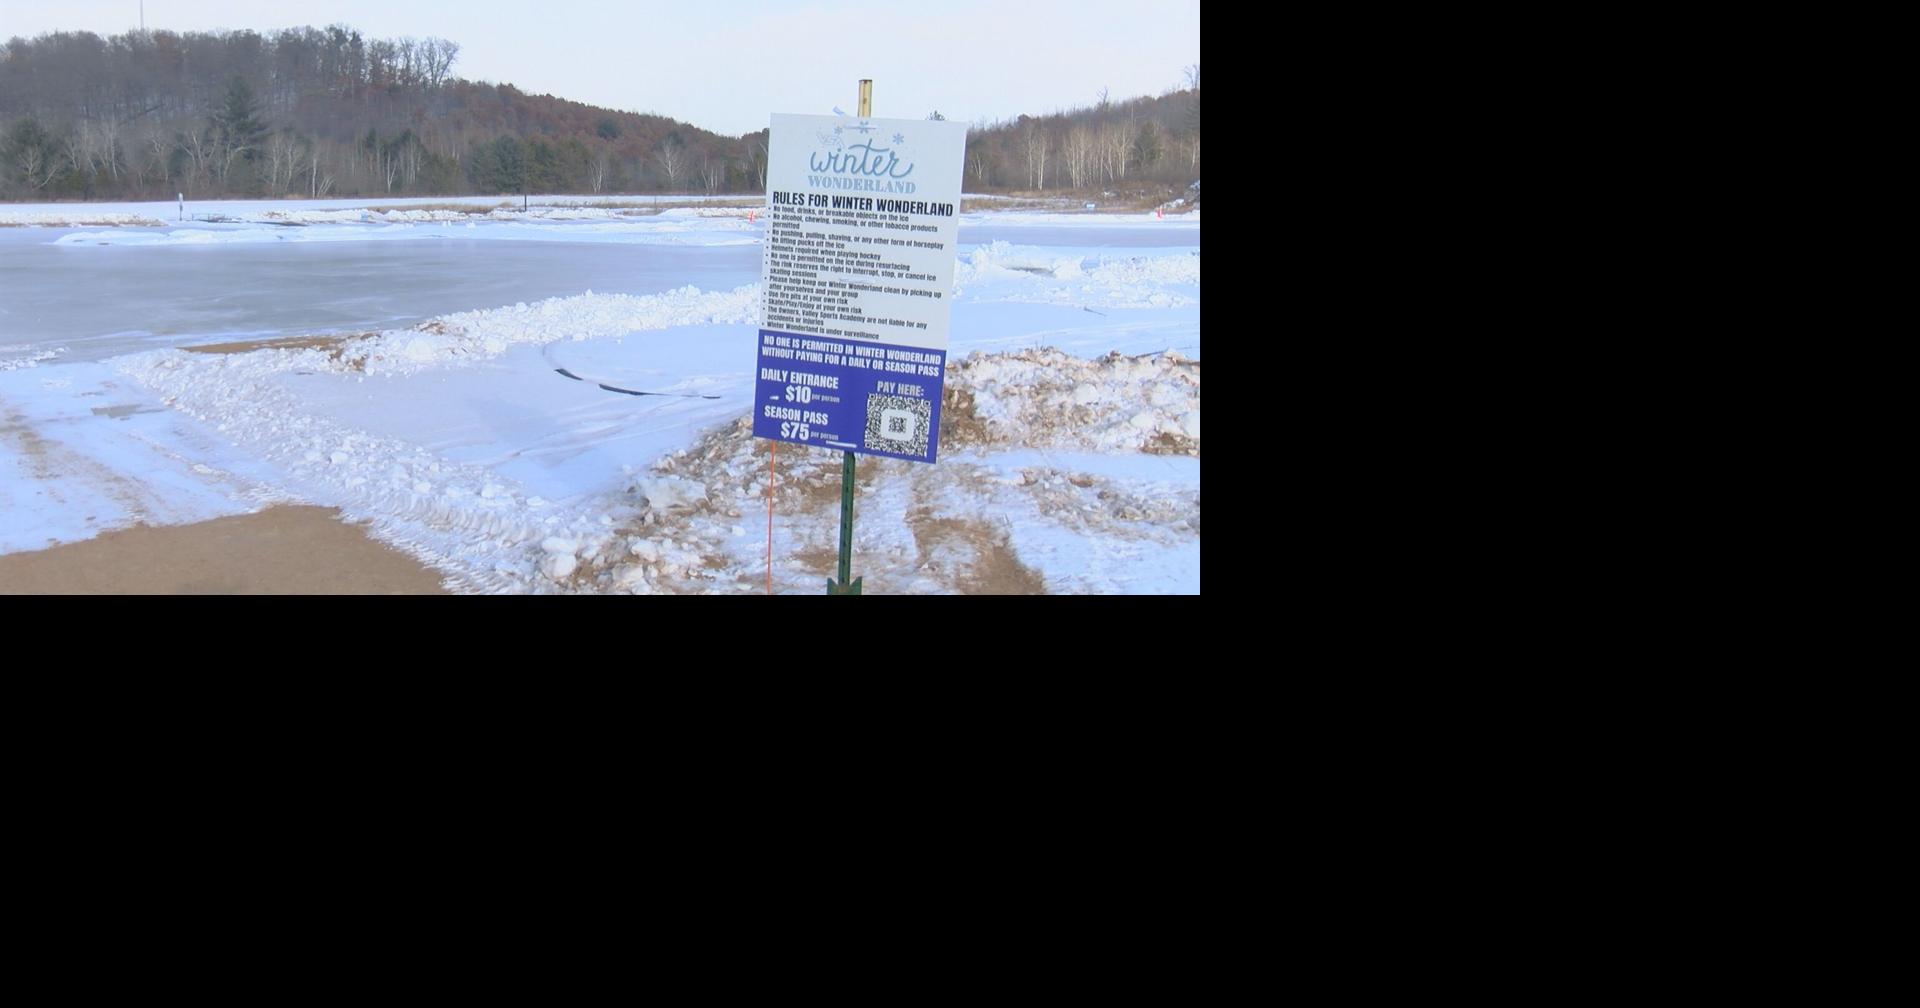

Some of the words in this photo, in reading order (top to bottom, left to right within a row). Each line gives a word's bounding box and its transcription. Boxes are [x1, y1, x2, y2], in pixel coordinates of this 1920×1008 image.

[810, 138, 915, 178] winter
[807, 175, 916, 195] WONDERLAND
[773, 191, 805, 206] RULES
[808, 194, 829, 208] FOR
[832, 196, 873, 211] WINTER
[876, 199, 953, 217] WONDERLAND
[826, 209, 854, 217] breakable
[856, 212, 878, 220] objects
[773, 221, 800, 230] permitted
[885, 222, 909, 230] tobacco
[911, 224, 938, 233] products
[798, 239, 814, 247] pucks
[914, 241, 944, 250] horseplay
[795, 247, 819, 255] required
[837, 250, 858, 259] playing
[860, 253, 881, 261] hockey
[794, 262, 818, 270] reserves
[797, 255, 825, 264] permitted
[856, 260, 874, 268] during
[876, 262, 910, 272] resurfacing
[770, 268, 791, 276] skating
[792, 270, 817, 278] sessions
[783, 285, 814, 294] yourselves
[827, 289, 840, 297] your
[841, 291, 858, 299] group
[789, 277, 801, 285] help
[828, 281, 847, 289] Winter
[848, 283, 882, 292] Wonderland
[910, 289, 932, 298] picking
[809, 295, 821, 303] your
[823, 304, 836, 312] your
[767, 314, 794, 322] accidents
[802, 318, 824, 326] injuries
[802, 310, 819, 318] Valley
[820, 312, 838, 320] Sports
[839, 314, 865, 323] Academy
[916, 322, 927, 330] any
[786, 323, 818, 332] Wonderland
[844, 330, 879, 339] surveillance
[764, 335, 774, 345] NO
[776, 337, 791, 347] ONE
[792, 339, 800, 348] IS
[802, 340, 843, 354] PERMITTED
[845, 345, 854, 355] IN
[855, 346, 885, 359] WINTER
[886, 350, 941, 366] WONDERLAND
[762, 346, 794, 359] WITHOUT
[796, 350, 823, 363] PAYING
[824, 354, 840, 365] FOR
[841, 356, 847, 366] A
[848, 357, 871, 369] DAILY
[873, 360, 884, 370] OR
[885, 361, 916, 374] SEASON
[918, 365, 940, 377] PASS
[761, 368, 788, 383] DAILY
[790, 372, 839, 389] ENTRANCE
[785, 384, 812, 404] $10
[821, 395, 840, 404] person
[877, 381, 896, 394] PAY
[898, 383, 924, 397] HERE:
[764, 406, 801, 422] SEASON
[803, 411, 829, 426] PASS
[781, 421, 810, 442] $75
[821, 433, 839, 442] person
